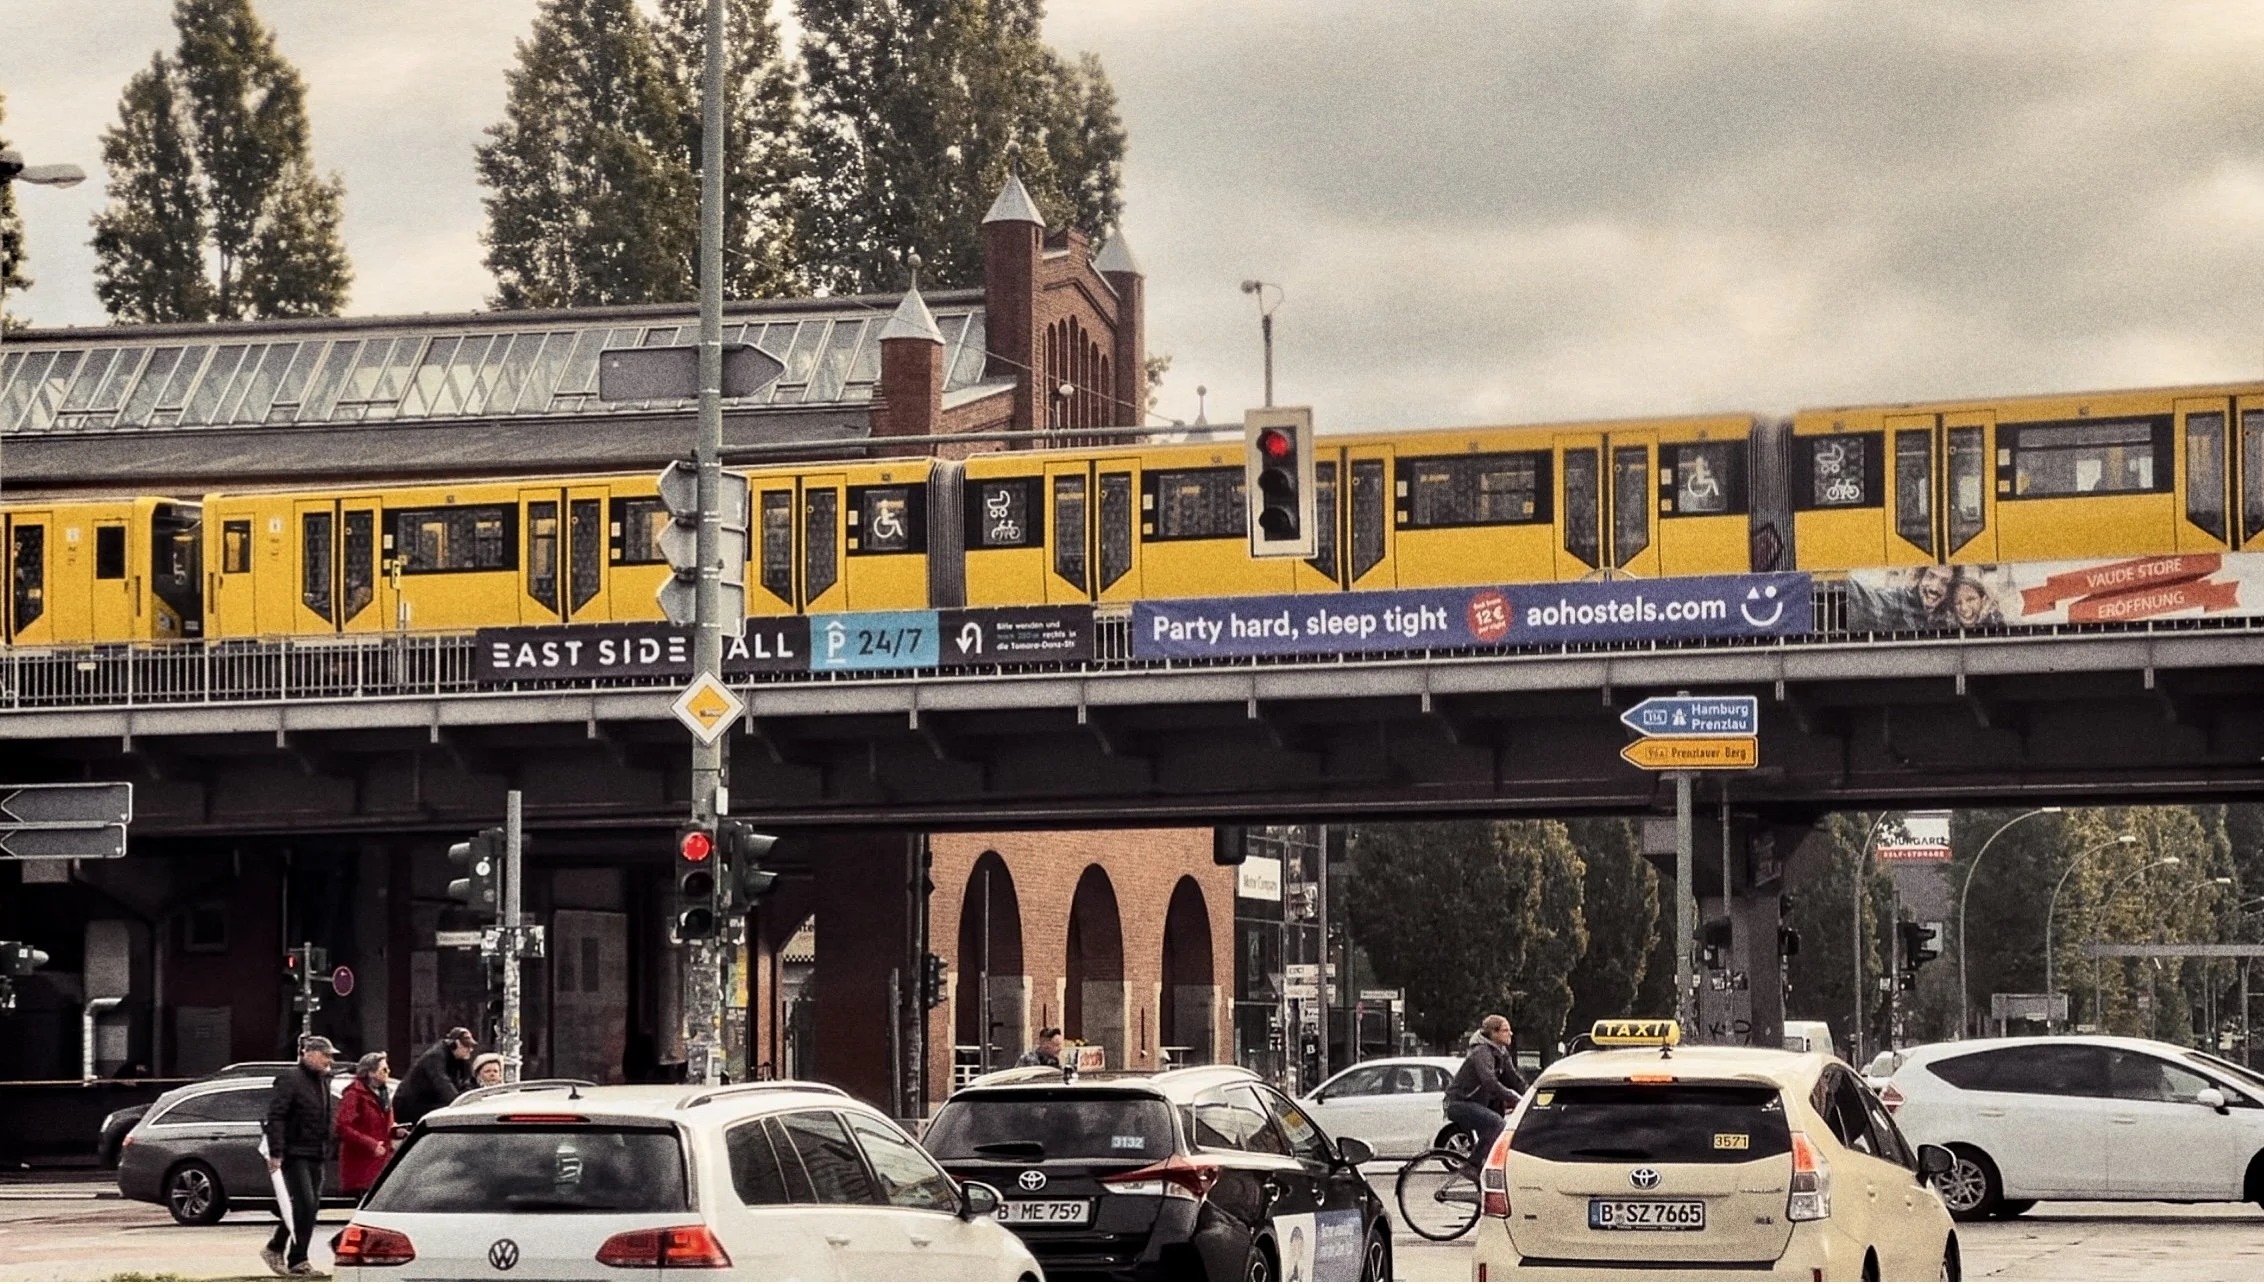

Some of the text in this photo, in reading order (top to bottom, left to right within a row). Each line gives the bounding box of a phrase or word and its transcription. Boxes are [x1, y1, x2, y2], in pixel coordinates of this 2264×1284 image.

[2087, 558, 2182, 588] VAUDE STORE
[1526, 596, 1727, 626] aohostels.com
[1153, 604, 1448, 645] Party hard, sleep tight
[492, 632, 795, 668] EAST SIDE ALL
[858, 628, 923, 658] 24/7
[1691, 703, 1749, 718] Hamburg
[1691, 718, 1747, 731] Prenzlau
[1671, 747, 1720, 759] Prenzlauer
[1725, 747, 1746, 760] Berg
[1605, 1023, 1661, 1037] TAXI
[1111, 1135, 1145, 1149] 3132
[1714, 1135, 1748, 1148] 3571
[997, 1203, 1082, 1220] B ME 759
[1601, 1204, 1702, 1223] B SZ 7665
